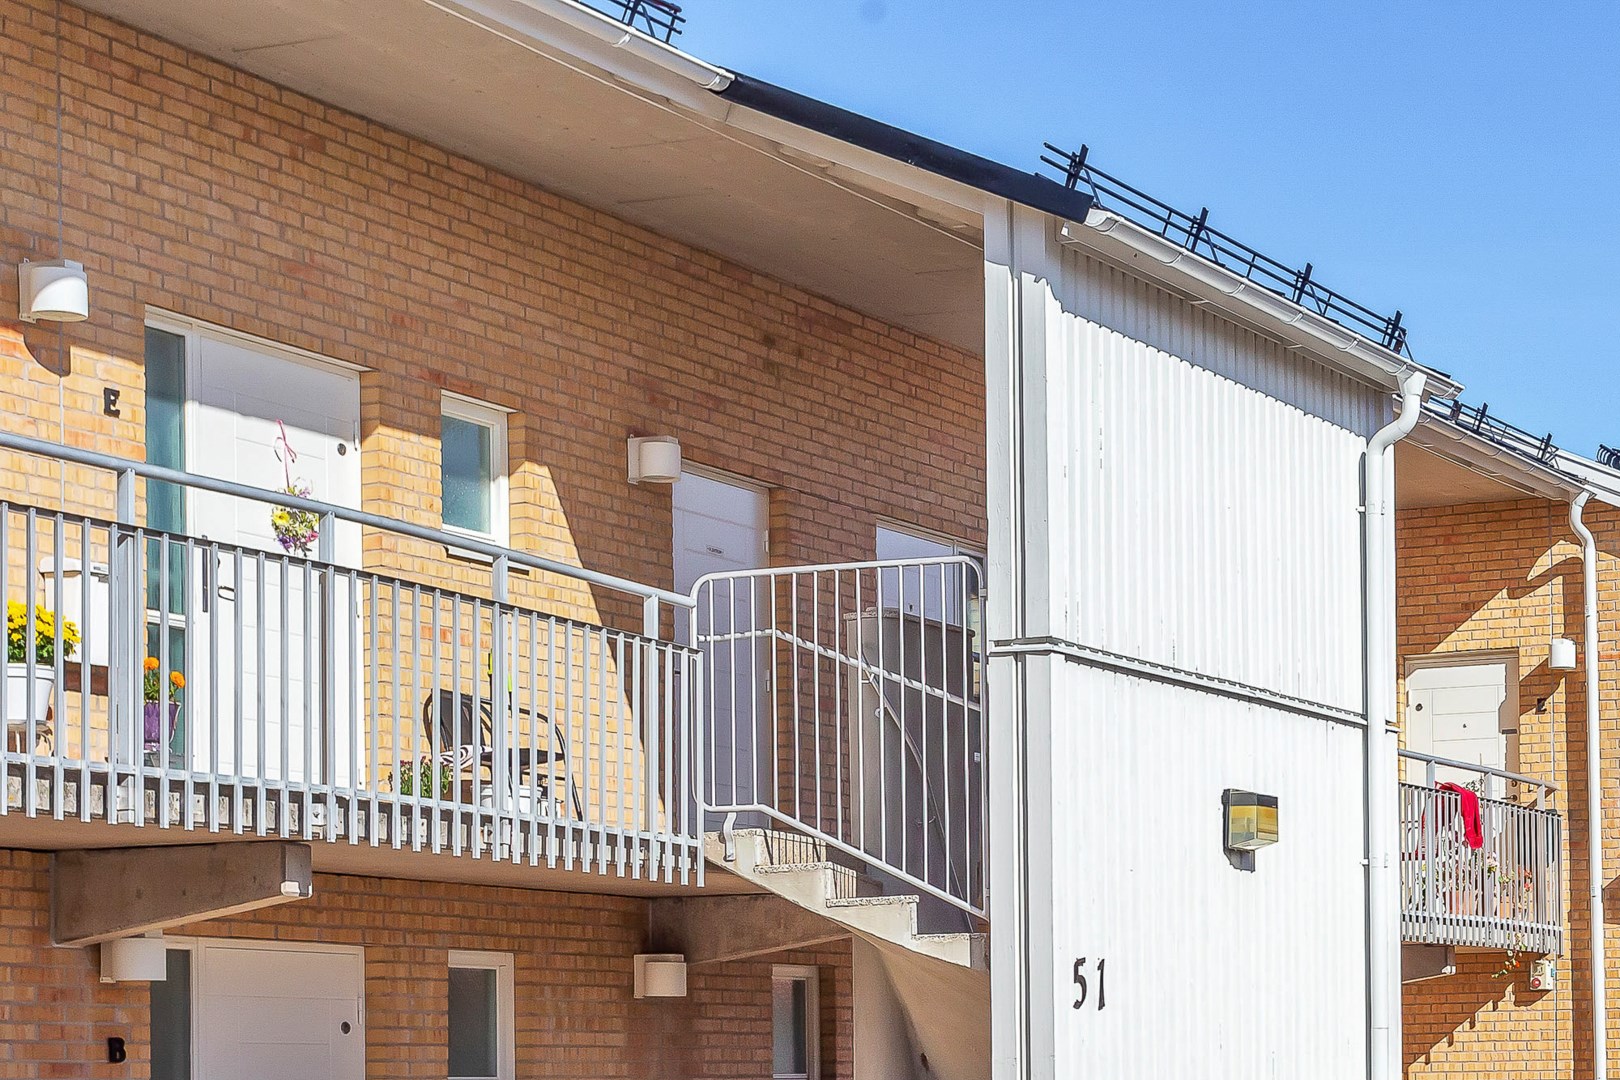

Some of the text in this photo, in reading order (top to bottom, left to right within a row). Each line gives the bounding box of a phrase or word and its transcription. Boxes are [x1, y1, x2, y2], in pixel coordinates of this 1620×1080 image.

[104, 387, 120, 418] E
[1073, 957, 1105, 1010] 51
[108, 1037, 126, 1063] B
